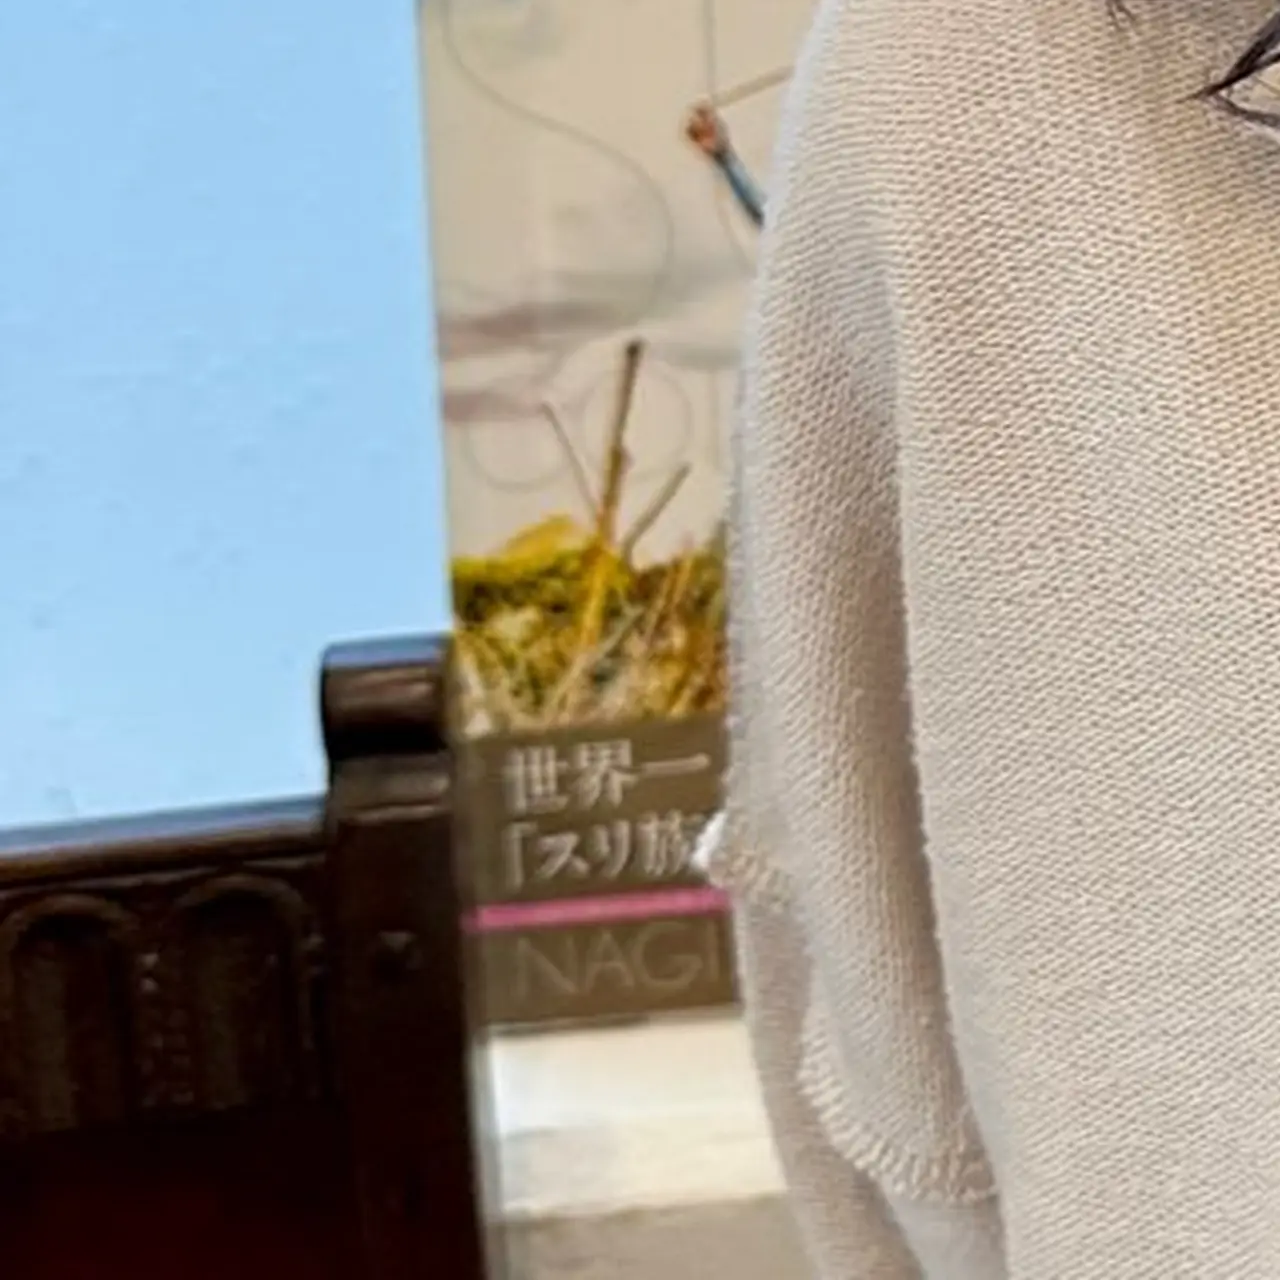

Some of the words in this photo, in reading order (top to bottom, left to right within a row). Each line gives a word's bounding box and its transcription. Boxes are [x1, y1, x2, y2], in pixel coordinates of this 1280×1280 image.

[502, 739, 712, 813] 世界一
[511, 921, 720, 1002] NAGI
